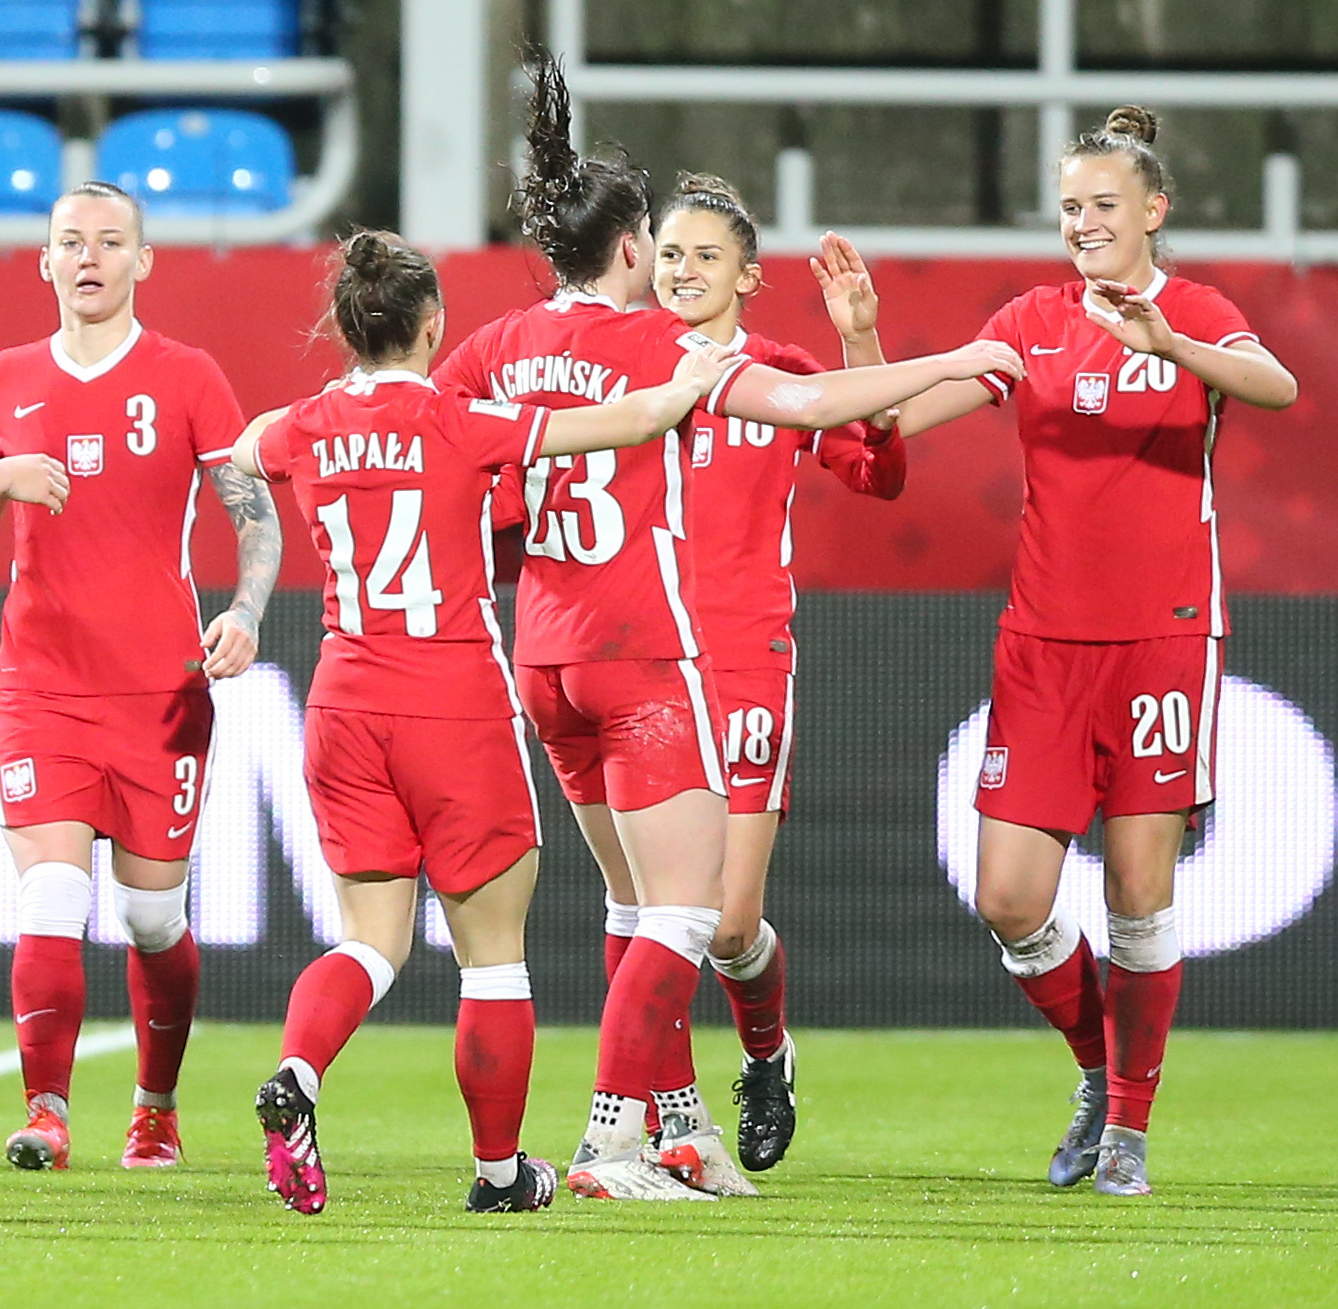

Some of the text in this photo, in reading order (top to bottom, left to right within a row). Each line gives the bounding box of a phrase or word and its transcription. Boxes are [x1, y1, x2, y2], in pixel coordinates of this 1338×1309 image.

[1116, 345, 1177, 392] 20
[125, 393, 157, 456] 3
[312, 432, 424, 478] ZAPAŁA
[524, 448, 627, 566] 23
[316, 489, 443, 638] 14
[727, 706, 773, 765] 18
[1131, 690, 1191, 758] 20
[173, 755, 197, 815] 3
